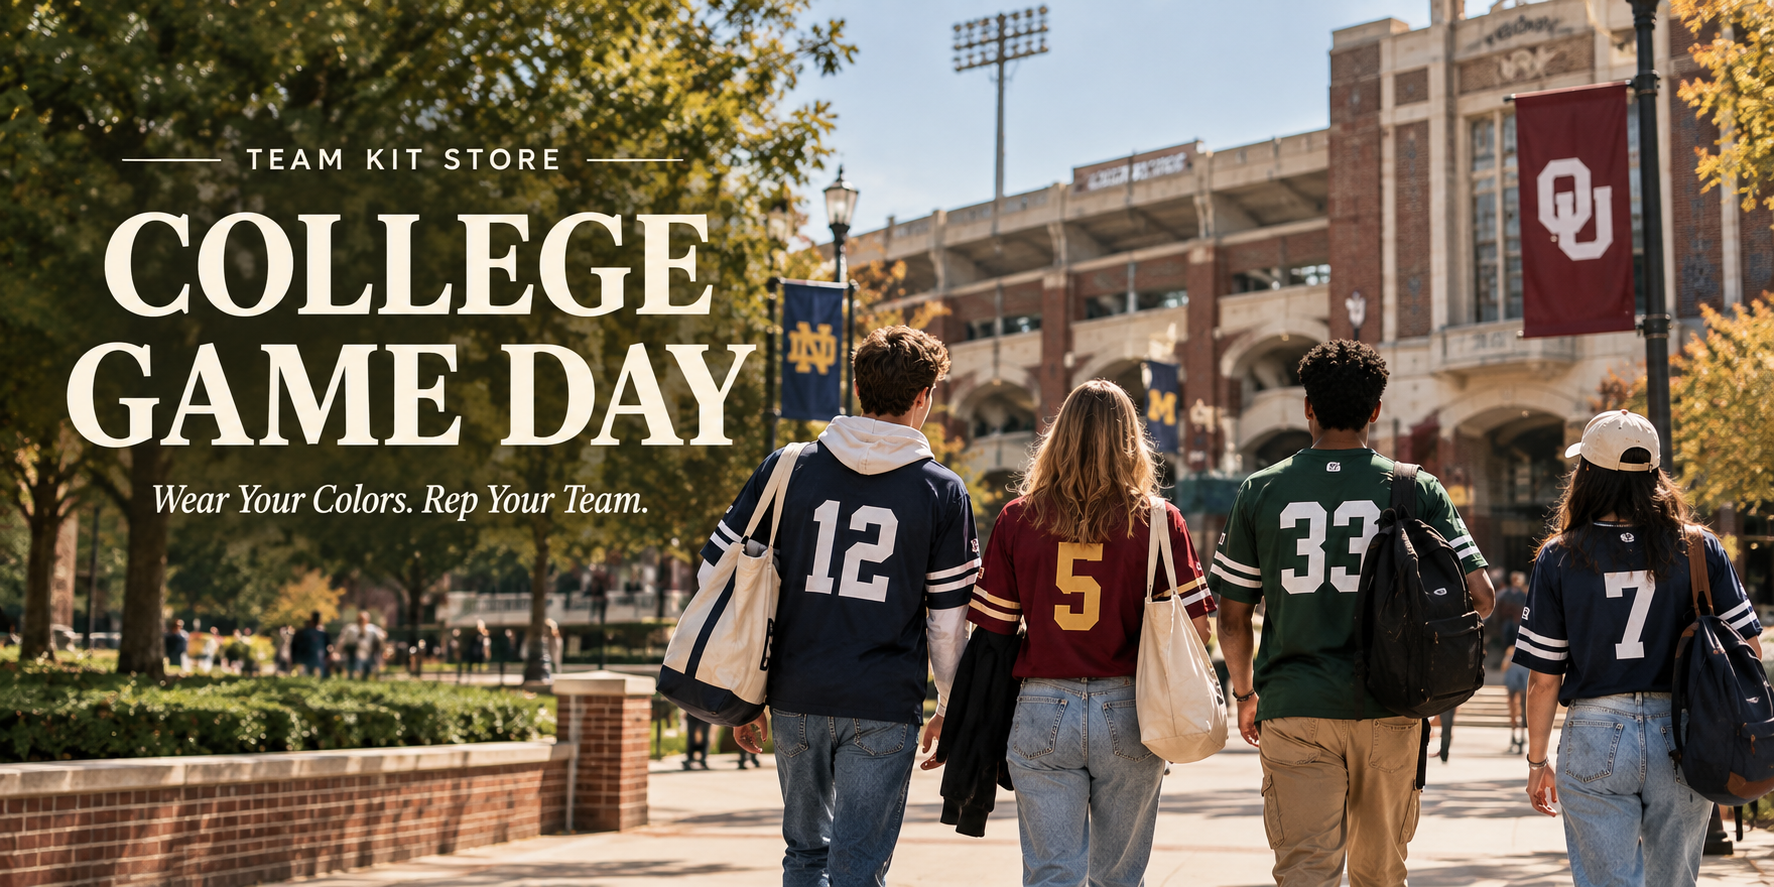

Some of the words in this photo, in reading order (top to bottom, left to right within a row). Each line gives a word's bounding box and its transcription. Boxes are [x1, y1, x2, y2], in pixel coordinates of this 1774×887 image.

[1537, 157, 1614, 261] OU
[1147, 388, 1177, 426] M
[805, 499, 899, 602] 12
[1054, 541, 1104, 631] 5
[1279, 500, 1381, 594] 33
[1603, 569, 1656, 660] 7
